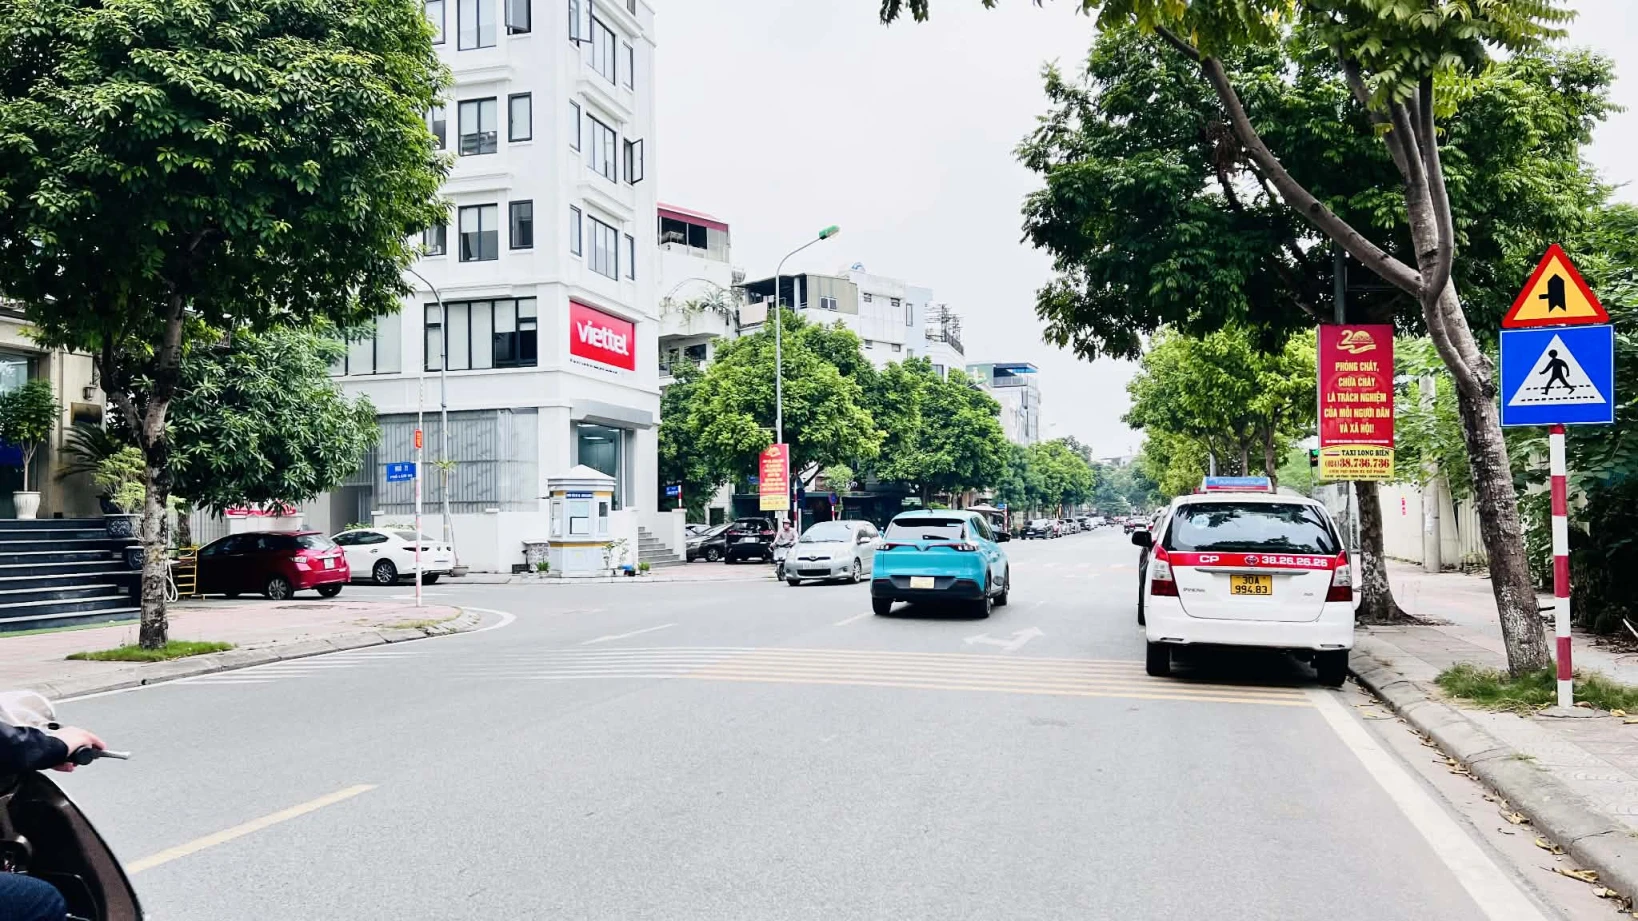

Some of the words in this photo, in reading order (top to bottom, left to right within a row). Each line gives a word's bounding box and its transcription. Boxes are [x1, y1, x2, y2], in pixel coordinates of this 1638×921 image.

[1335, 360, 1358, 372] PHÒNG
[1338, 375, 1356, 387] CHỮA
[1357, 375, 1376, 387] CHÁY
[1327, 391, 1336, 402] LÀ
[1337, 391, 1358, 402] TRÁCH
[1360, 390, 1387, 404] NGHIỆM
[1324, 405, 1338, 418] CỦA
[1339, 405, 1352, 418] MỖI
[1354, 406, 1375, 418] NGƯỜI
[1376, 406, 1390, 418] DÂN
[1340, 422, 1348, 433] VÀ
[1350, 422, 1359, 433] XÃ
[1199, 555, 1220, 563] CP
[1261, 556, 1329, 567] 38.26.26.26
[1242, 576, 1260, 585] 30A
[1235, 585, 1268, 594] 994.83
